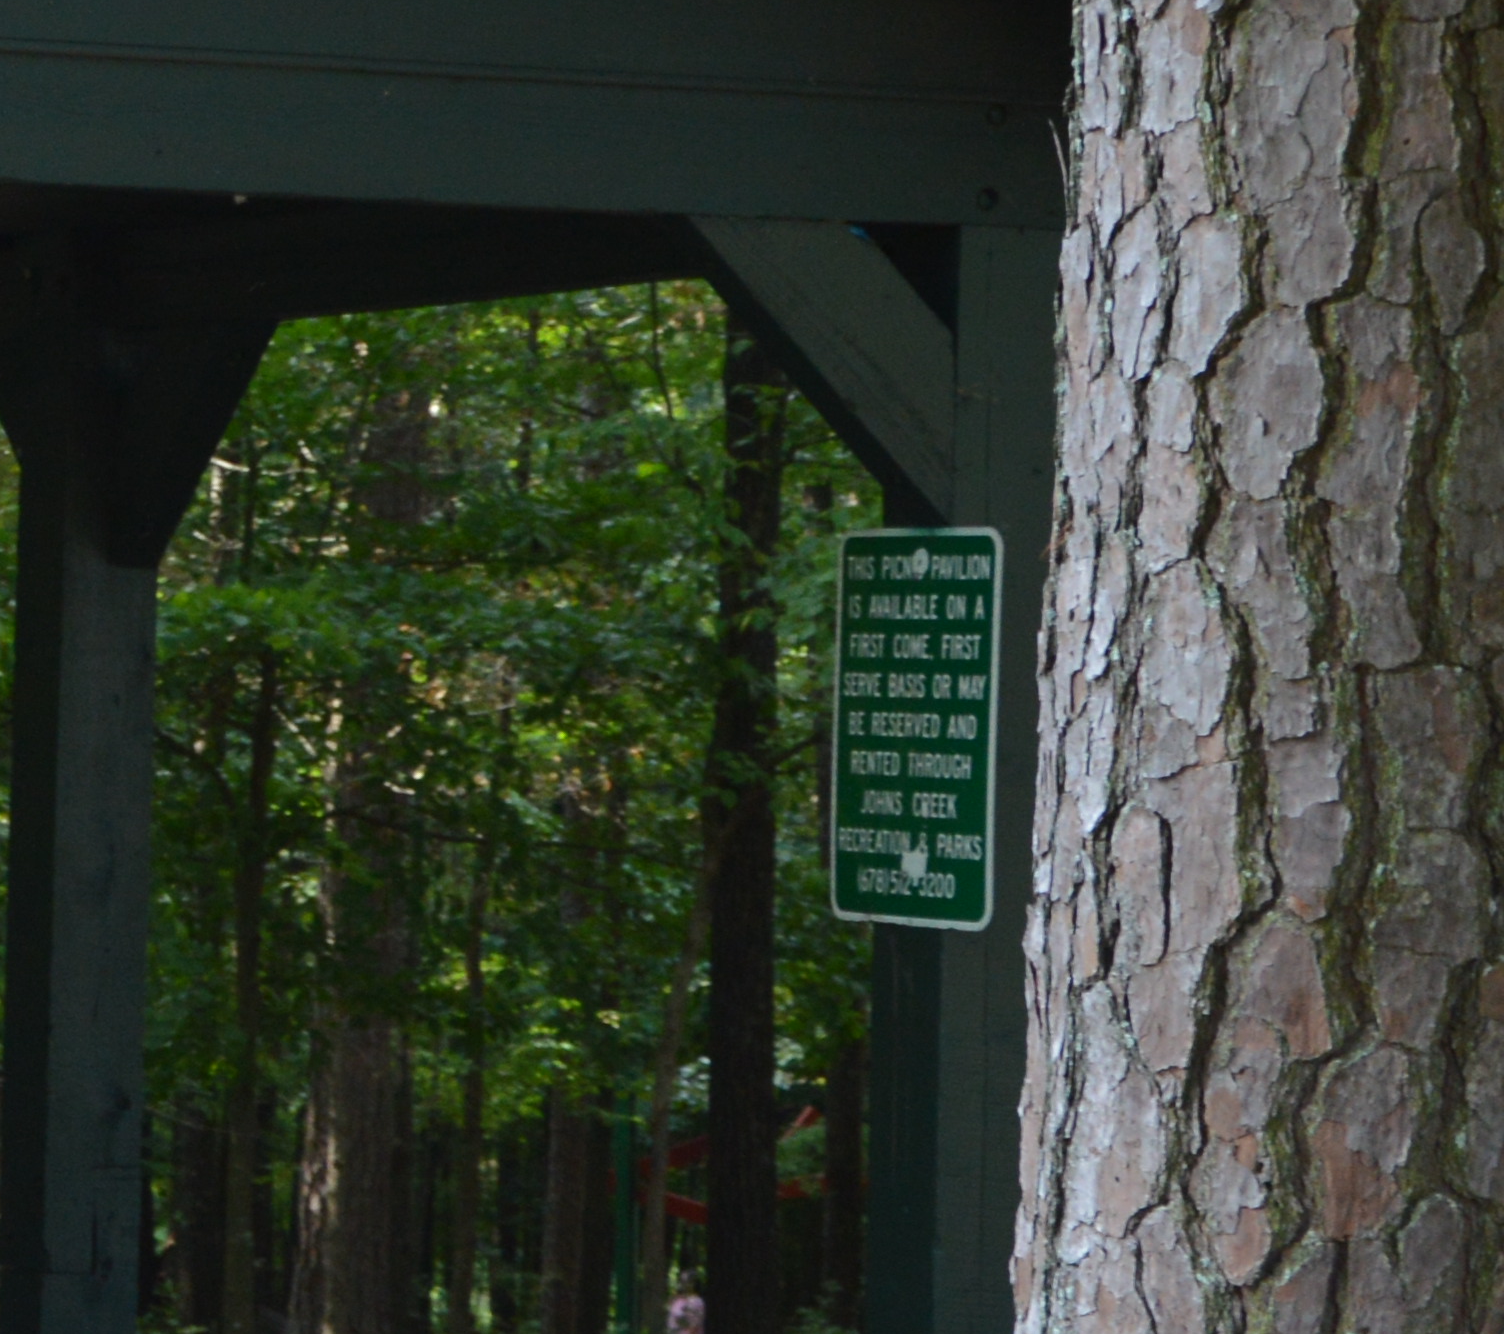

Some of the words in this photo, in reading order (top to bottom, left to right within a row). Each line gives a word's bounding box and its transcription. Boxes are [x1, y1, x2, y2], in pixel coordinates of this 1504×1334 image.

[847, 555, 874, 580] THIS
[882, 555, 925, 580] PICN
[931, 555, 991, 580] PAVILION
[849, 594, 862, 619] IS
[869, 594, 938, 619] AVAILABLE
[946, 594, 967, 620] ON
[974, 595, 985, 620] A
[850, 633, 885, 658] FIRST
[941, 634, 981, 660] FIRST
[843, 672, 882, 697] SERVE
[888, 672, 926, 698] BASIS
[932, 673, 952, 699] OR
[957, 674, 987, 700] MAY
[848, 711, 865, 736] BE
[870, 712, 941, 739] RESERVED
[947, 714, 977, 740] AND
[850, 750, 900, 776] RENTED
[908, 752, 972, 780] THROUGH
[860, 789, 903, 816] JOHNS
[912, 791, 957, 819] CREEK
[838, 827, 911, 855] RECREATION
[935, 833, 983, 861] PARKS
[856, 867, 956, 899] (678)5123200
